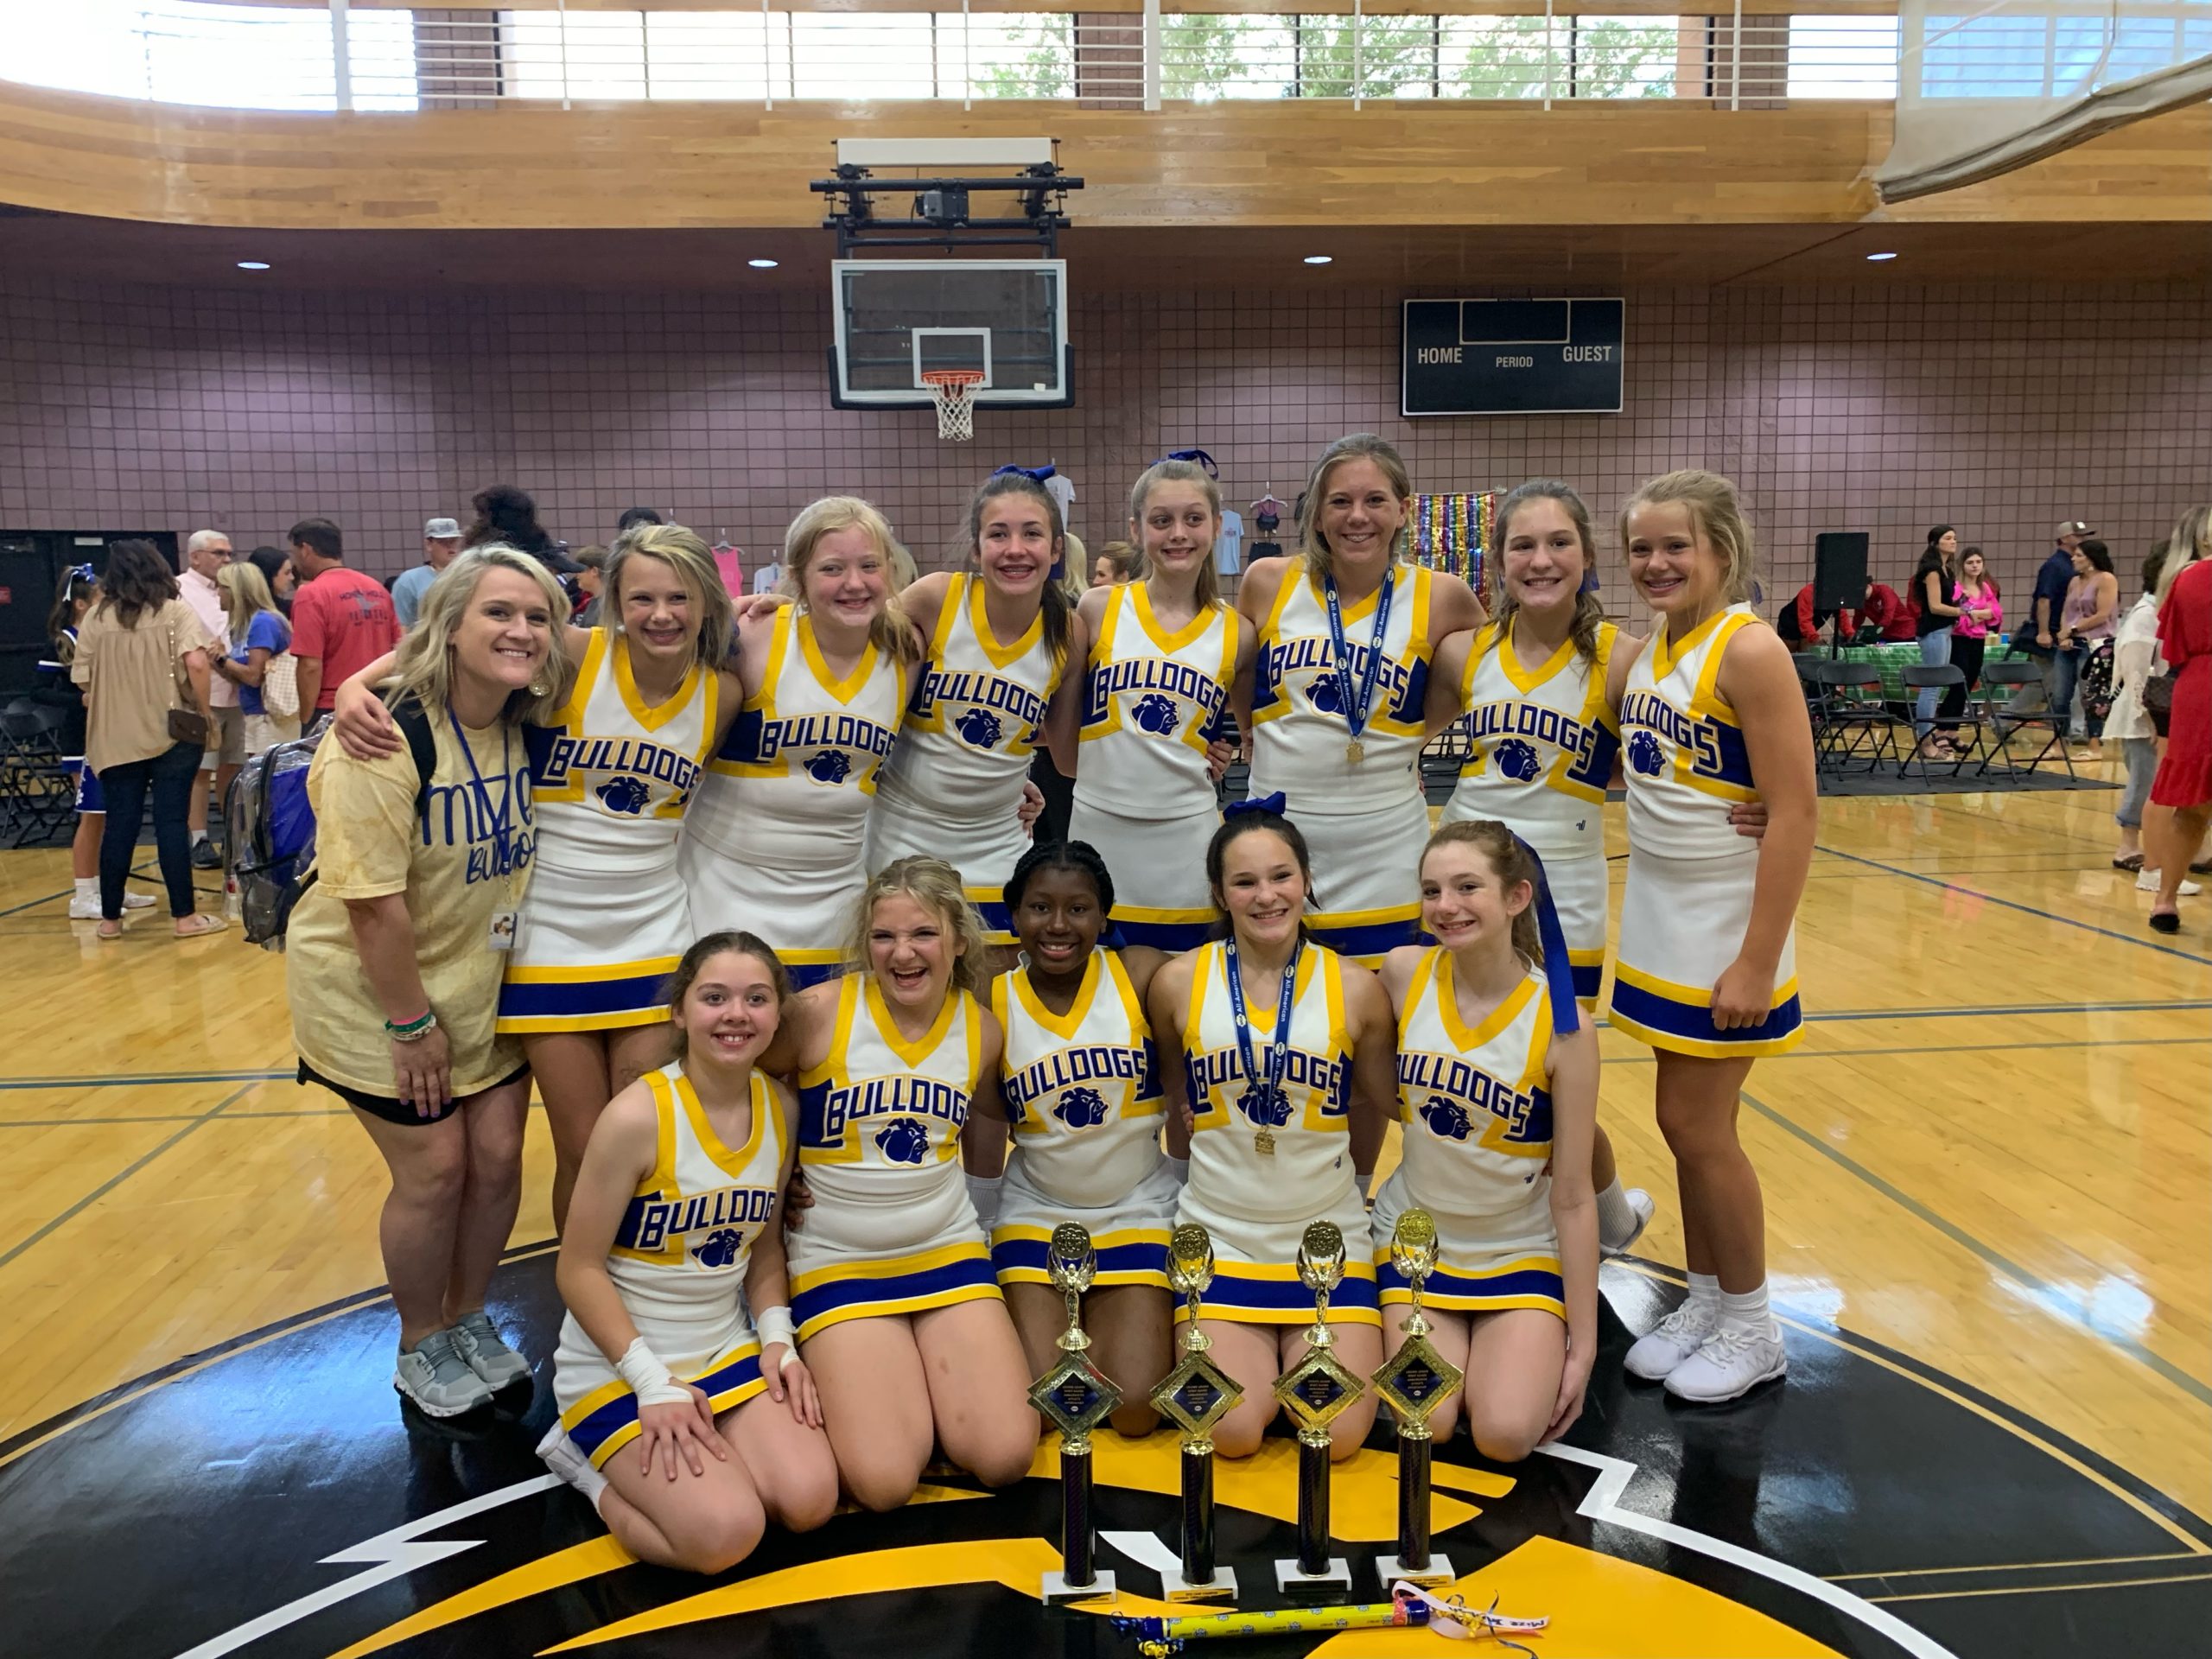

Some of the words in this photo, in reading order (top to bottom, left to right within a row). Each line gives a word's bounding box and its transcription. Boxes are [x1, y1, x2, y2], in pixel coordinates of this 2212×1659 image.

[1418, 347, 1463, 364] HOME
[1496, 356, 1534, 367] PERIOD
[1562, 346, 1612, 362] GUEST
[1094, 660, 1224, 728] BULLDOGS
[1362, 666, 1375, 707] All-American
[1231, 971, 1243, 1013] All-American
[1281, 979, 1292, 1022] All-American
[1007, 1047, 1147, 1119] BULLDOGS
[1192, 1046, 1340, 1108] BULOGS
[1396, 1053, 1532, 1134] ULLDOGS
[826, 1078, 969, 1139] BULLDOG
